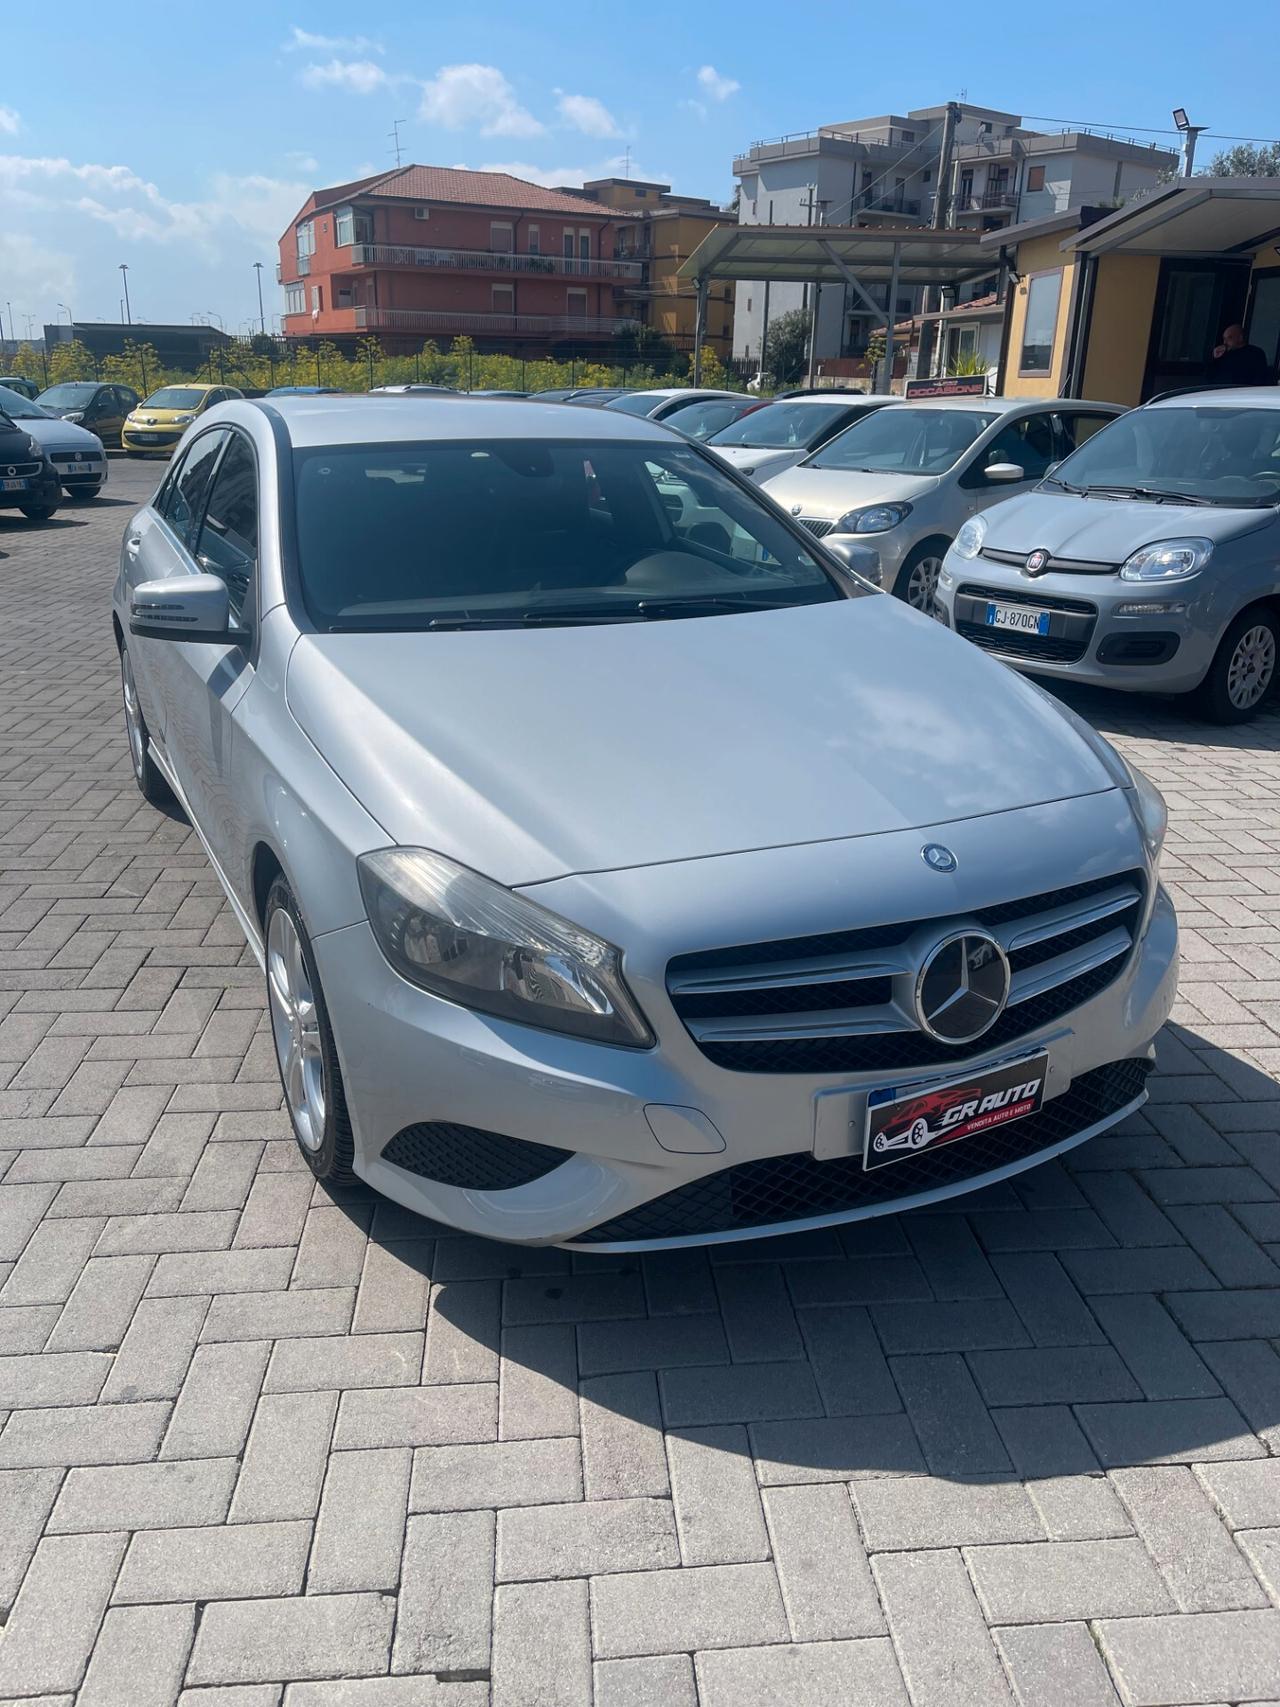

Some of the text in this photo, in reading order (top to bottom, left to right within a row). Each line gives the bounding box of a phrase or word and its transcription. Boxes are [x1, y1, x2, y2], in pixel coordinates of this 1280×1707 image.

[942, 1078, 1042, 1126] GR AUTO
[967, 1103, 1031, 1131] VENDITA AUTO E MOTO
